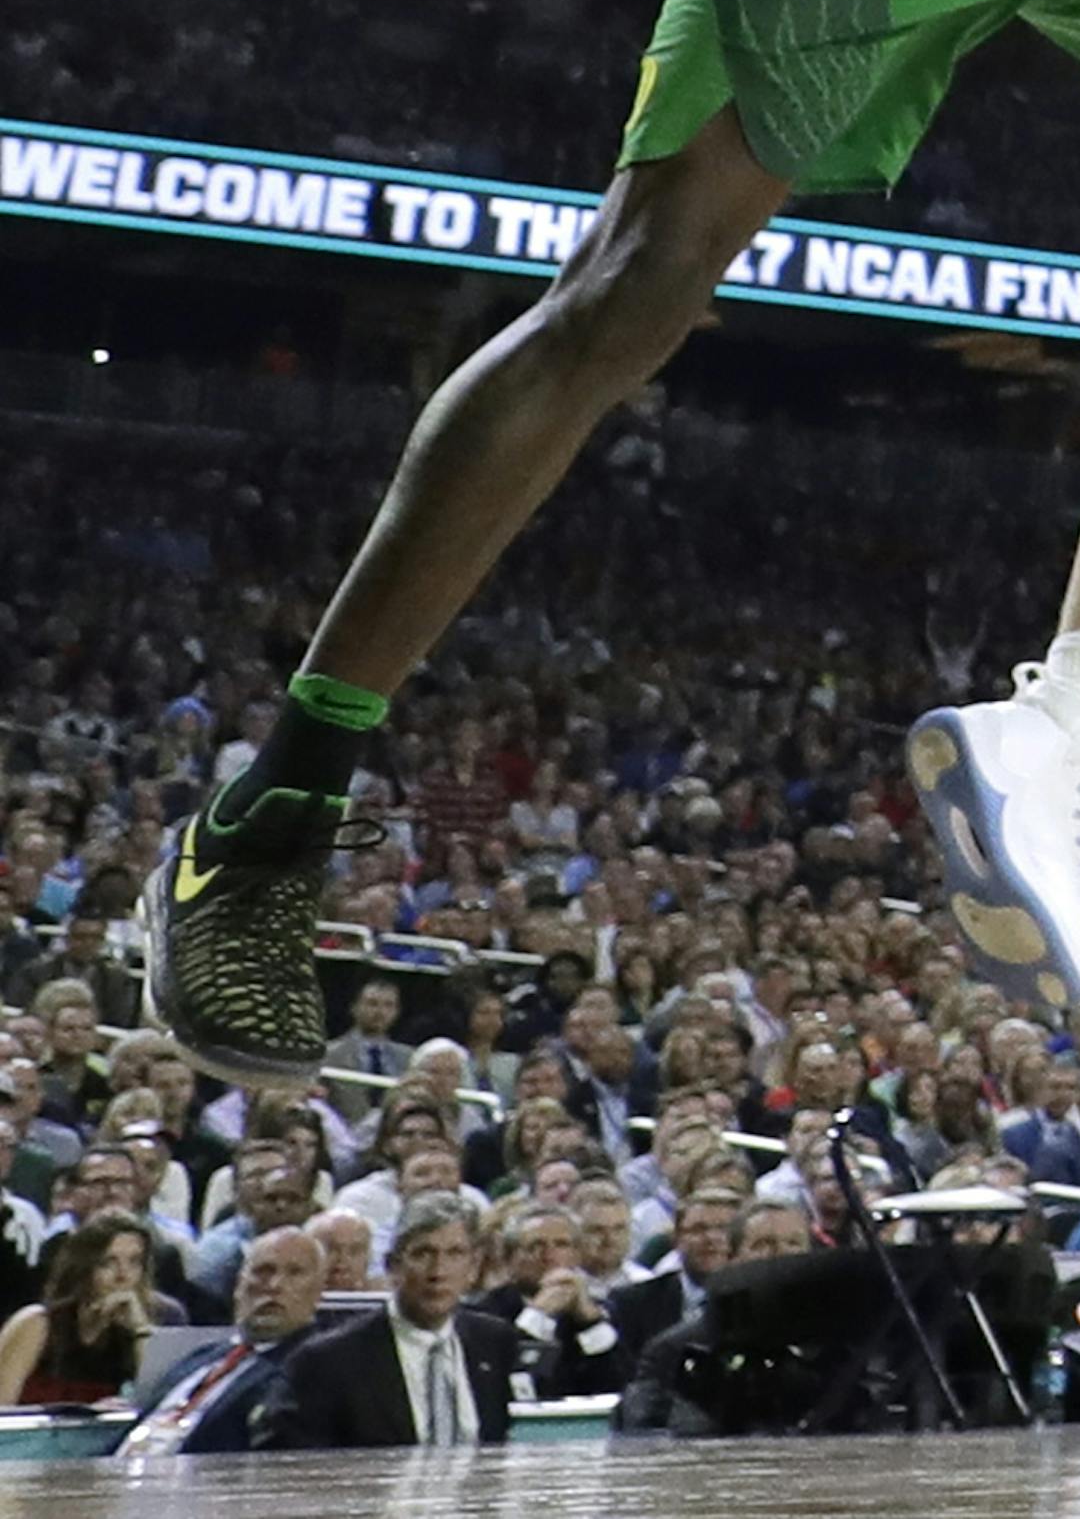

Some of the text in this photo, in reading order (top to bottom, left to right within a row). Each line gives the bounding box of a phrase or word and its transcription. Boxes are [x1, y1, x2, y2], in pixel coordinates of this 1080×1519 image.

[0, 136, 372, 238] WELCOME
[384, 184, 475, 250] TO
[805, 238, 972, 311] NCAA
